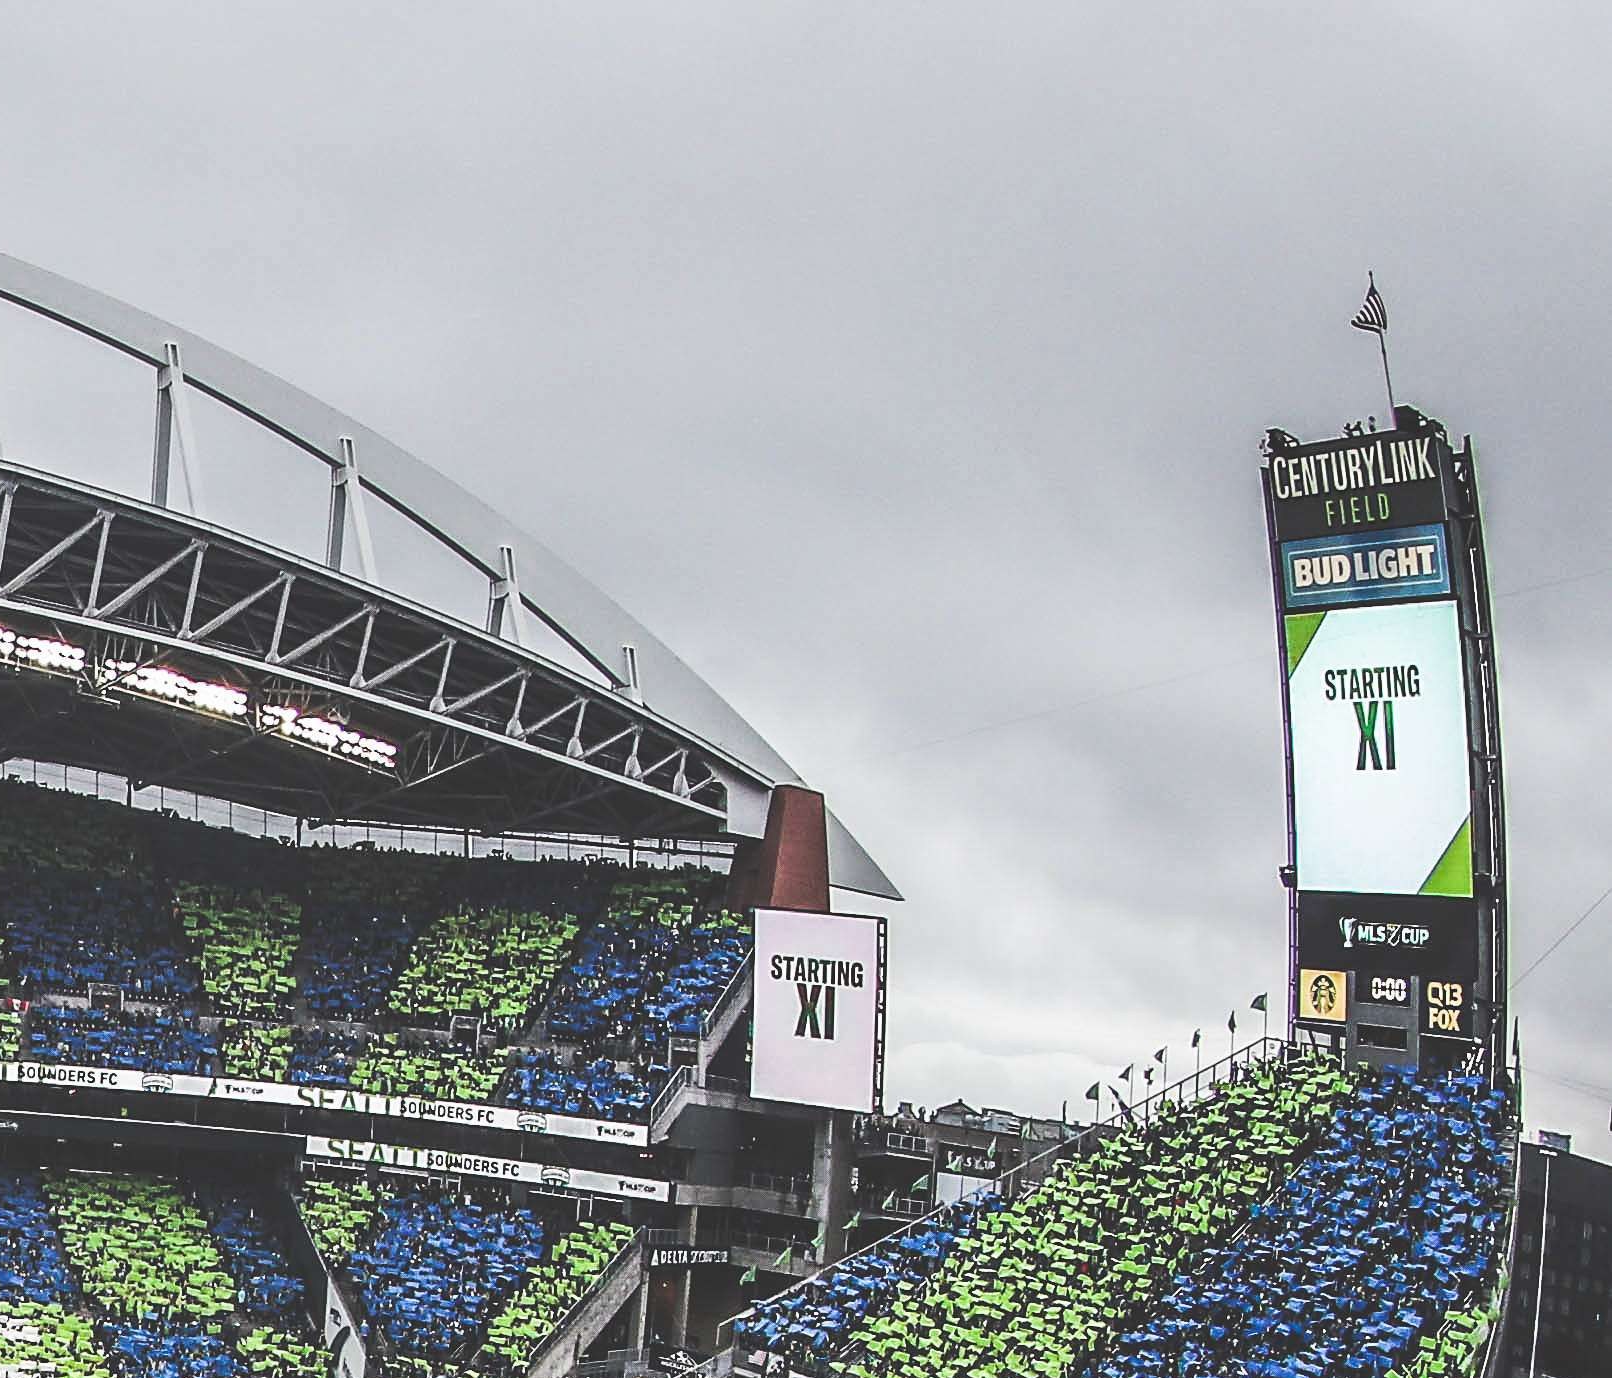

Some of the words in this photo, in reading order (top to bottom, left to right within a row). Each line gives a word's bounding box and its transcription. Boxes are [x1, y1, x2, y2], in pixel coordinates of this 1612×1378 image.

[1273, 437, 1436, 500] CENTURYLINK
[1325, 492, 1391, 527] FIELD
[1294, 552, 1351, 587] BUD
[1354, 543, 1435, 580] LIGHT
[1324, 664, 1421, 701] STARTING
[1353, 700, 1397, 771] XI
[1356, 924, 1386, 944] MLS
[1400, 926, 1430, 946] CUP
[770, 953, 864, 989] STARTING
[1370, 976, 1407, 1002] 0:00
[1426, 980, 1463, 1008] Q13
[794, 983, 837, 1041] XI
[1428, 1006, 1461, 1031] FOX
[17, 1065, 96, 1084] SOUNDERS
[100, 1071, 118, 1086] FC
[399, 1099, 475, 1122] SOUNDERS
[477, 1105, 495, 1124] FC
[426, 1151, 499, 1175] SOUNDERS
[501, 1158, 520, 1177] FC
[660, 1249, 688, 1265] DELTA
